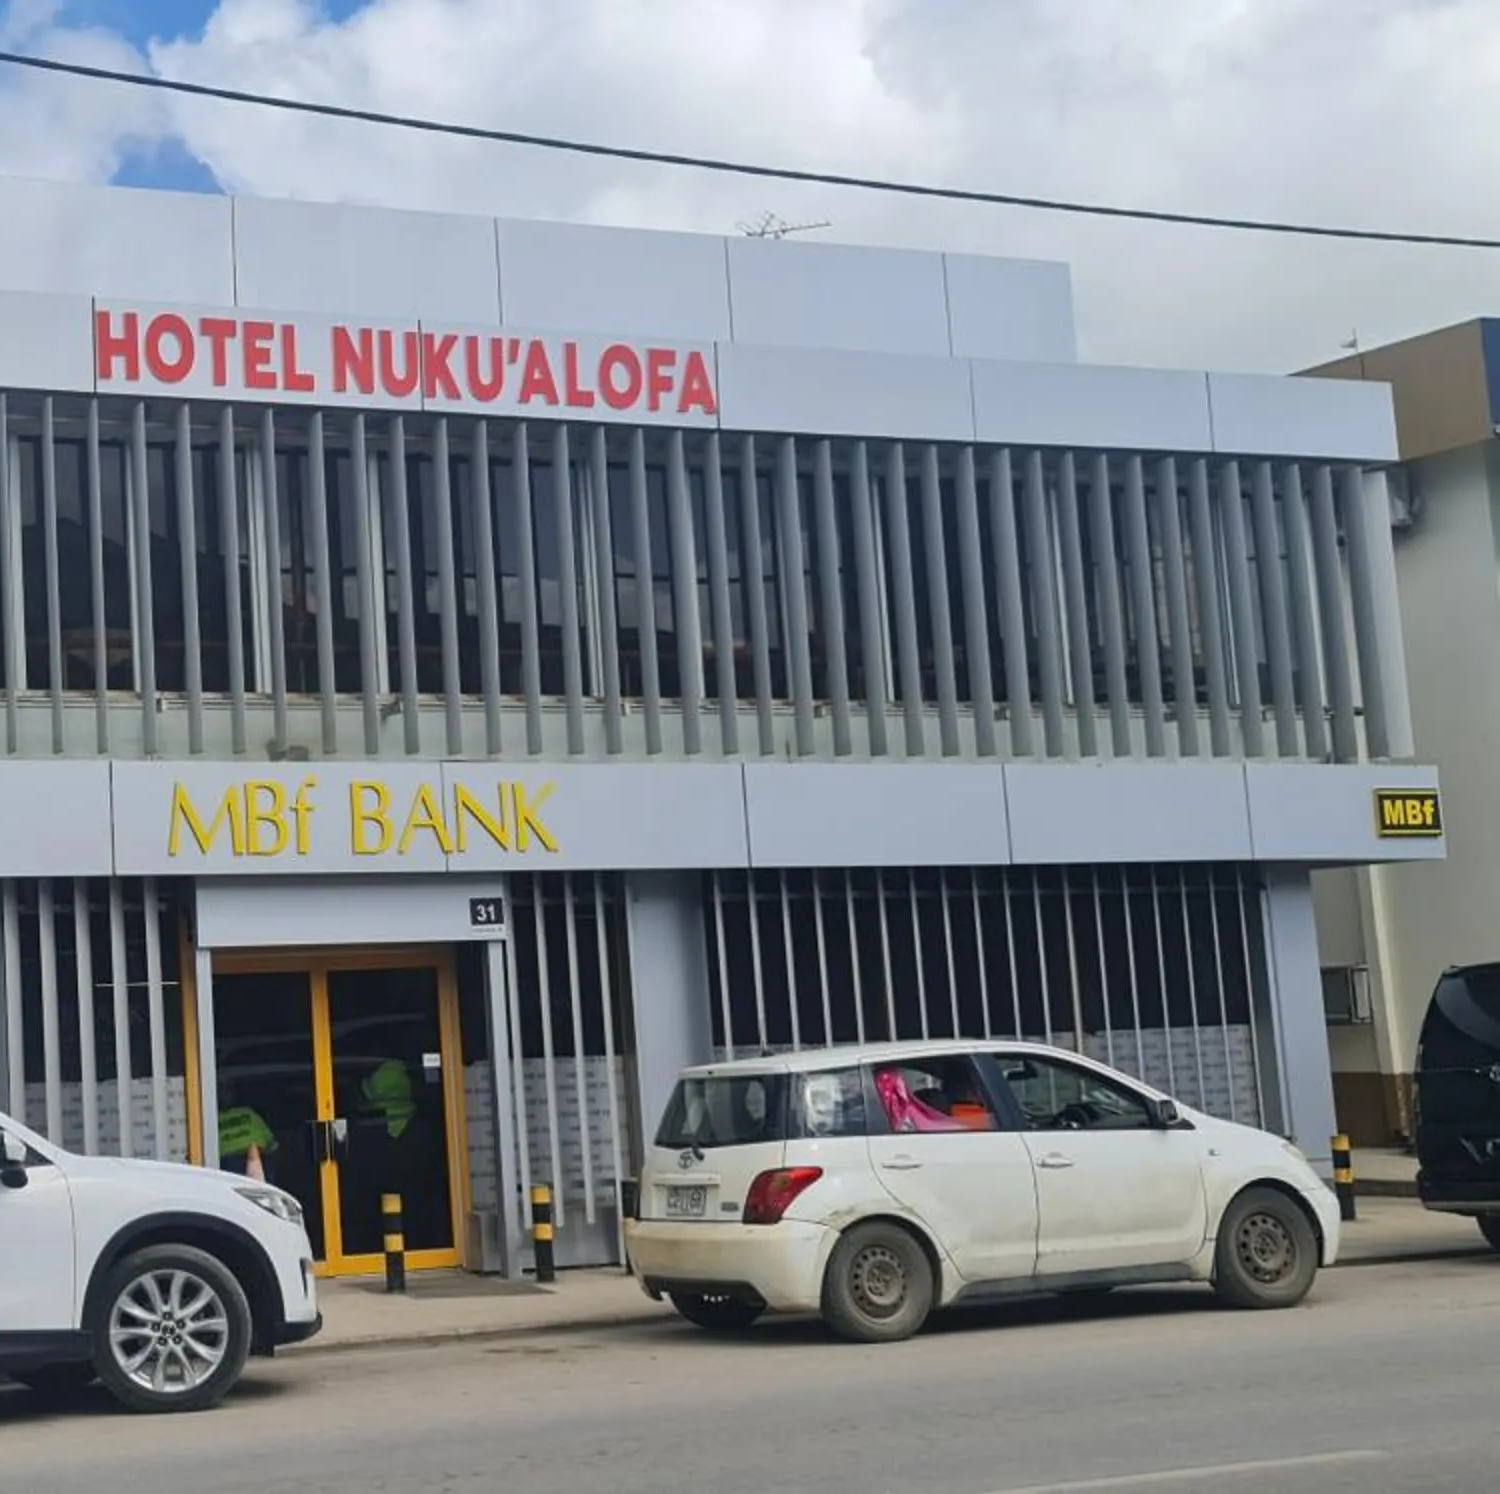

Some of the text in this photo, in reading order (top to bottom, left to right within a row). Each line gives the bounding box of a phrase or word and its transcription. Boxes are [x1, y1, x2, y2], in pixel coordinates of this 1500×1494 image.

[95, 311, 716, 415] HOTEL NUKU'ALOFA
[168, 775, 559, 857] MBf BANK
[1383, 798, 1434, 825] MBf
[476, 904, 495, 922] 31
